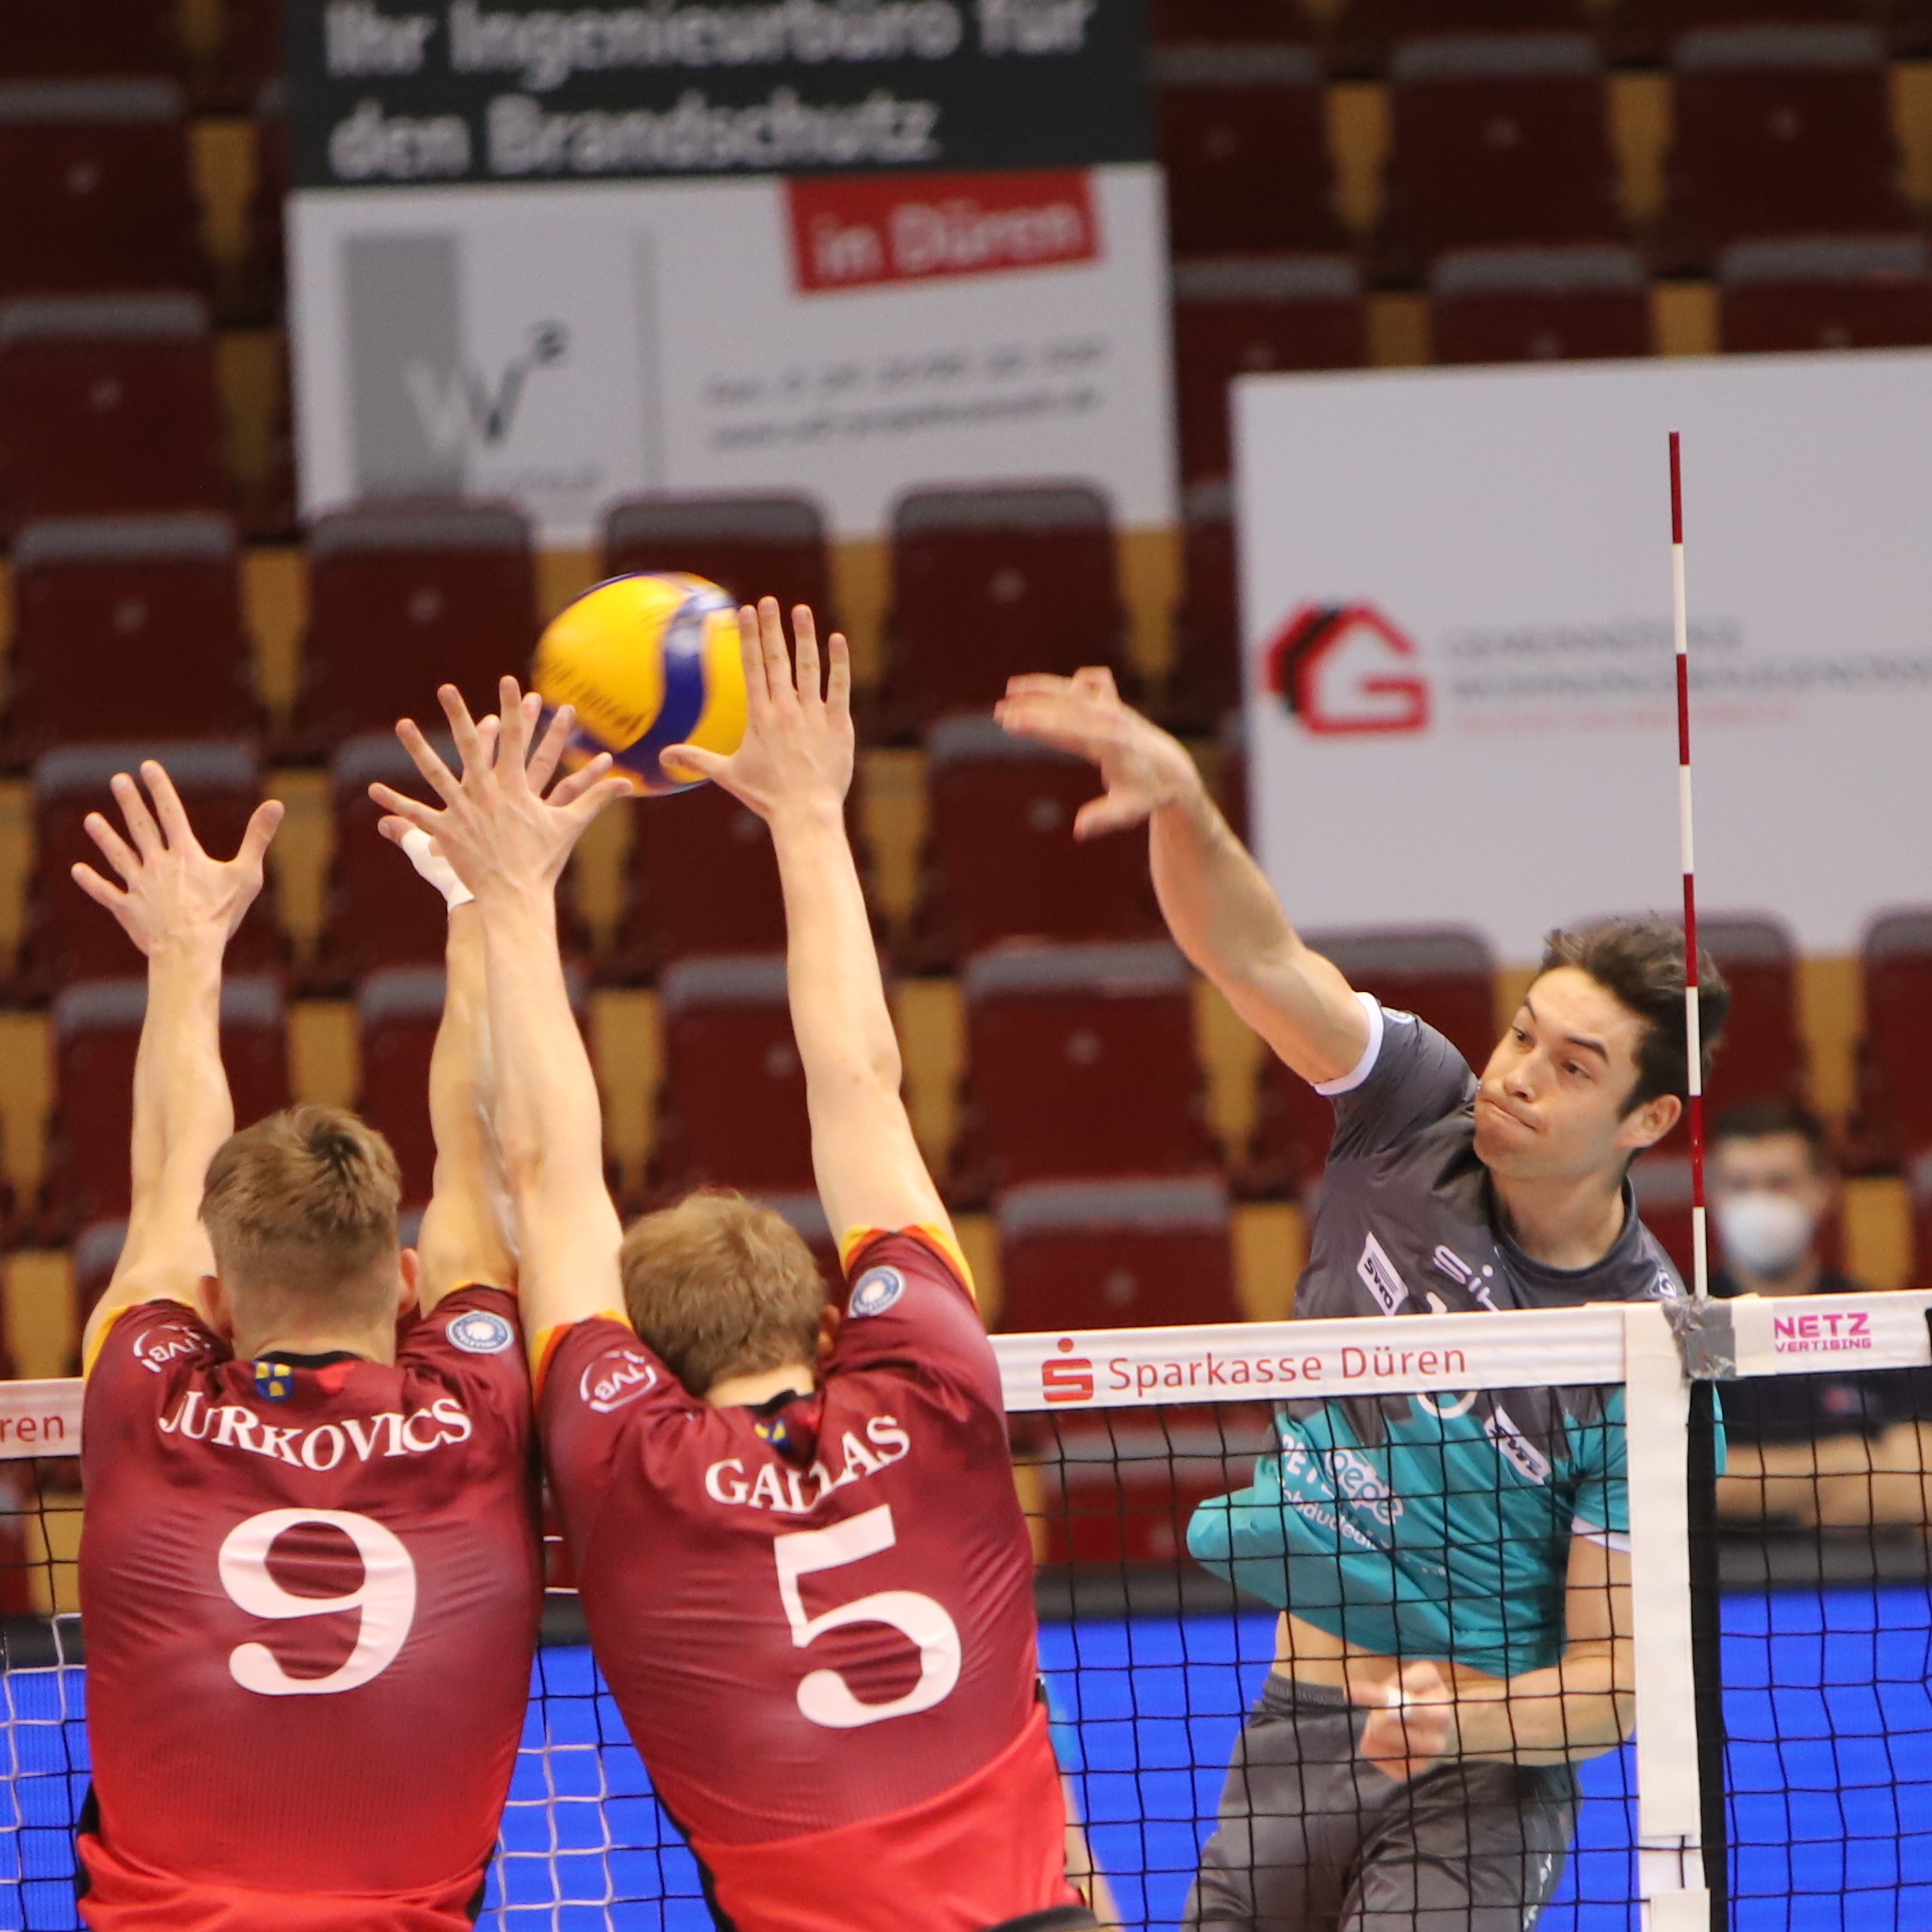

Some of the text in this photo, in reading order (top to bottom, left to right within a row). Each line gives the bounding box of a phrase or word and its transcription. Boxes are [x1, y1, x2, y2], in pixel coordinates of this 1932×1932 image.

[327, 0, 437, 75] Ihr
[450, 0, 963, 91] Ingenieurbüro
[330, 87, 942, 178] den Brandschutz
[811, 196, 1085, 280] in Düren
[1775, 1313, 1870, 1339] NETZ
[1109, 1352, 1323, 1398] Sparkasse
[1342, 1346, 1467, 1380] Düren
[159, 1389, 473, 1472] JURKOVICS
[704, 1415, 910, 1514] GALLAS
[218, 1507, 416, 1695] 9
[773, 1504, 961, 1728] 5
